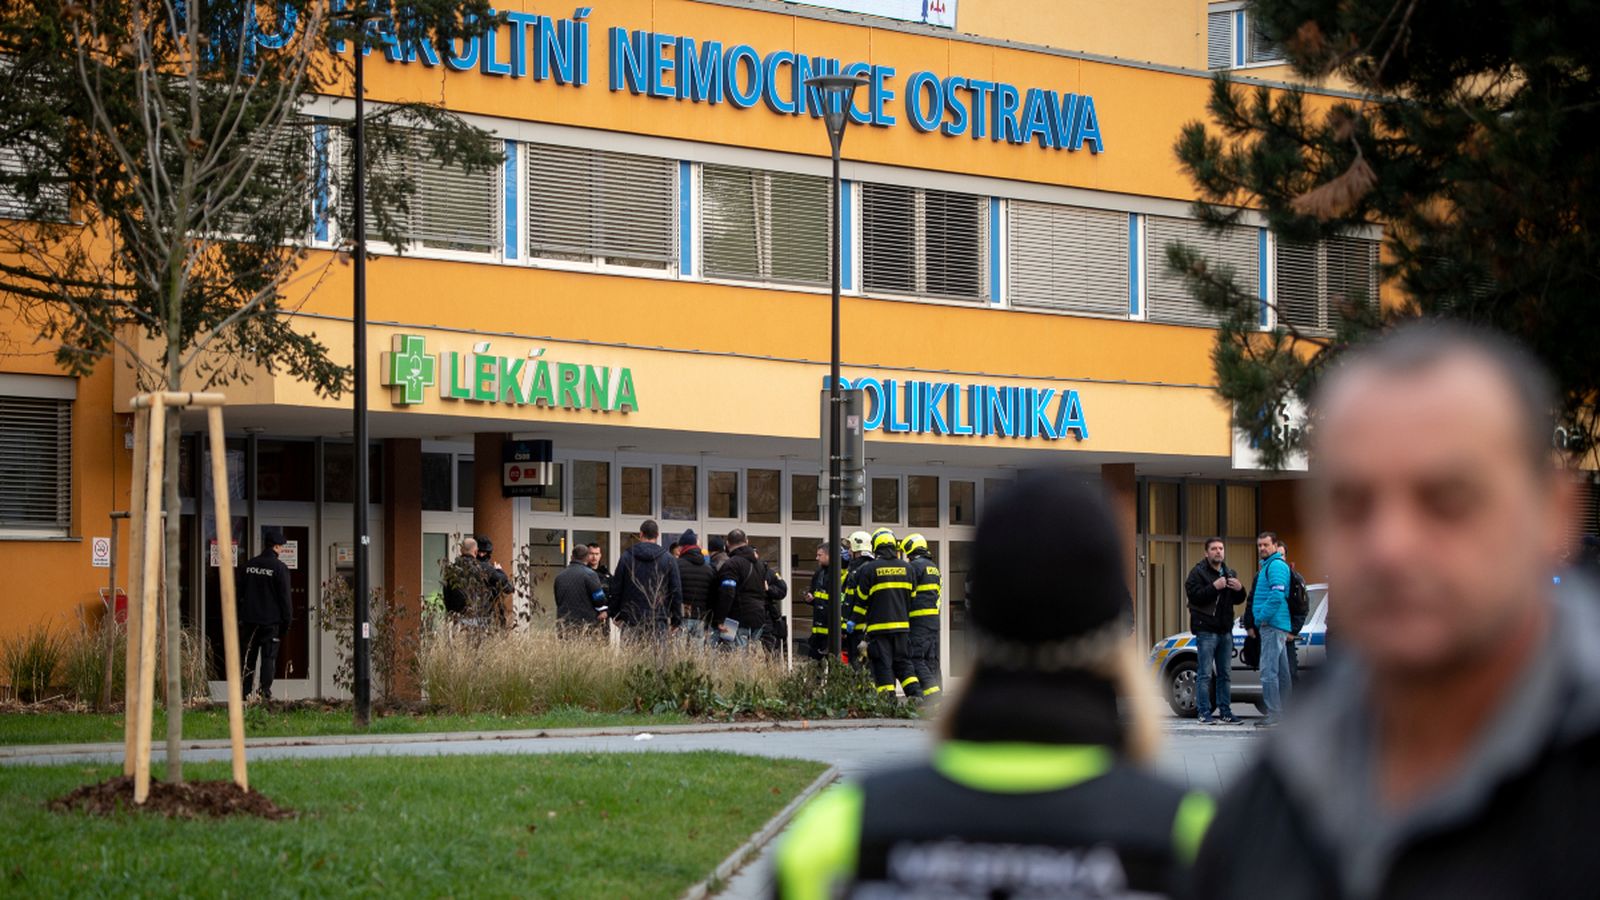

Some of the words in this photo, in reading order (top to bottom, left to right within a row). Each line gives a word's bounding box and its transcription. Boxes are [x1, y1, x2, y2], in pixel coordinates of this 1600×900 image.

[608, 26, 896, 127] NEMOCNICE
[906, 70, 1104, 154] OSTRAVA
[440, 342, 639, 414] LÉKÁRNA
[823, 375, 1090, 441] OLIKLINIKA
